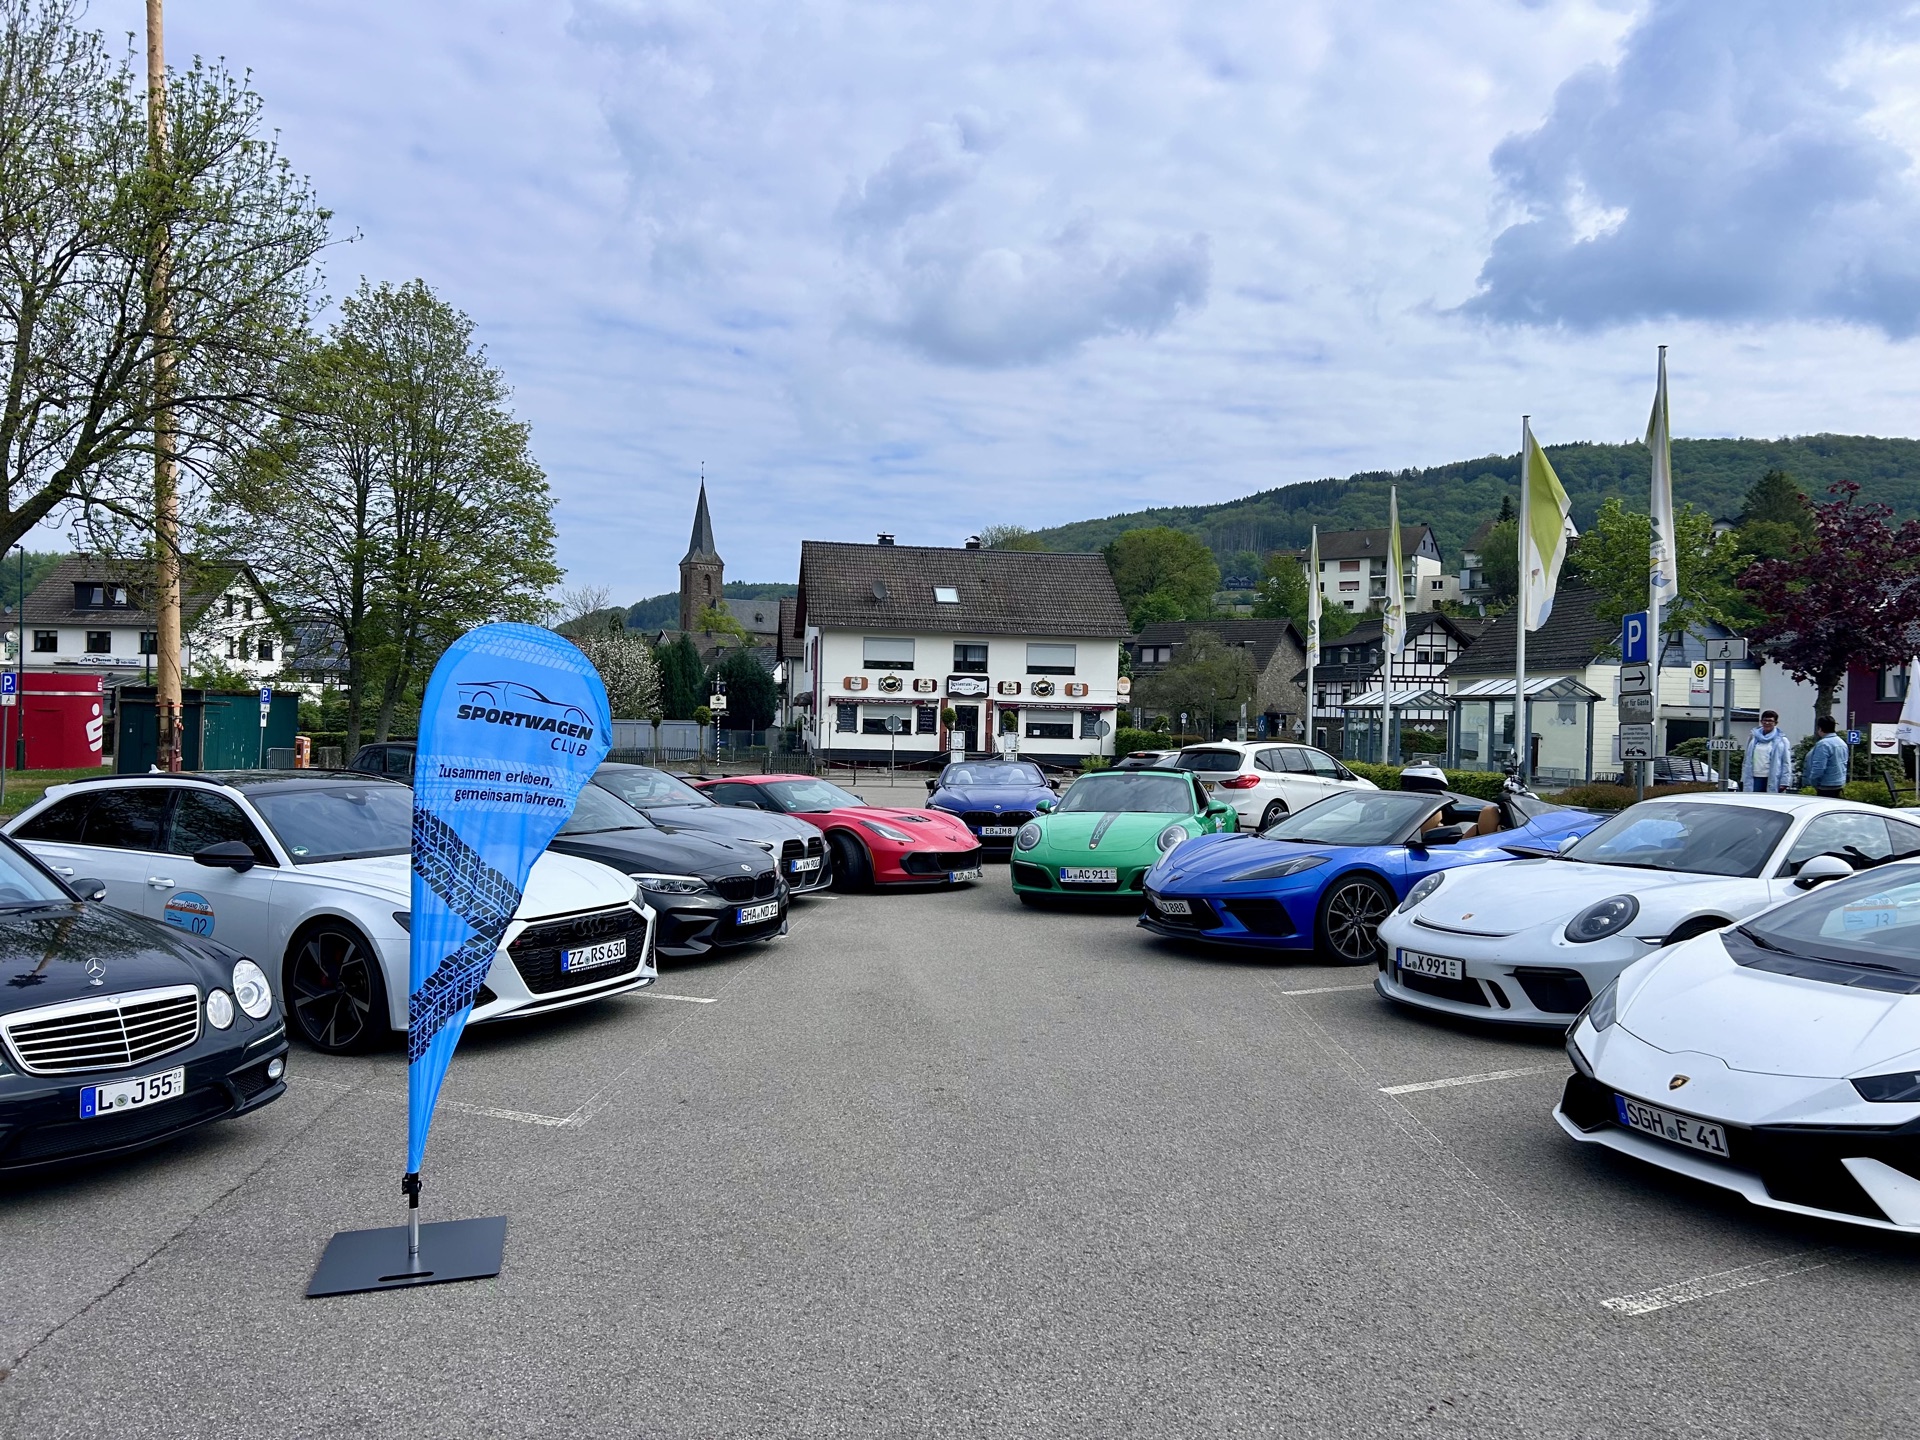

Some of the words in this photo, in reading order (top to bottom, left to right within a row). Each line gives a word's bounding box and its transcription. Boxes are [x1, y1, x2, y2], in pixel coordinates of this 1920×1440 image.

[1628, 620, 1641, 657] P
[1697, 667, 1704, 675] H
[4, 675, 12, 691] P
[262, 690, 269, 701] P
[1637, 698, 1649, 706] Gäste
[457, 704, 594, 741] SPORTWAGEN
[1711, 741, 1735, 749] KIOSK
[1850, 732, 1858, 742] P
[551, 737, 588, 757] CLUB
[439, 764, 501, 782] Zusammen
[506, 771, 553, 789] erleben,
[455, 788, 523, 803] gemeinsam
[985, 827, 995, 835] EB
[1066, 870, 1073, 879] L
[1078, 870, 1090, 879] AC
[1092, 870, 1110, 879] 911
[741, 908, 757, 922] GHA
[760, 905, 770, 917] ND
[770, 904, 778, 915] 21
[1169, 902, 1186, 912] 888
[192, 917, 207, 934] 02
[569, 950, 584, 967] ZZ
[591, 946, 605, 963] RS
[606, 941, 625, 959] 630
[1404, 953, 1411, 968] L
[1417, 955, 1424, 971] X
[1426, 957, 1448, 975] 991
[98, 1089, 114, 1111] L
[131, 1081, 145, 1104] J
[150, 1073, 173, 1099] 55
[1626, 1102, 1666, 1135] SGH
[1675, 1118, 1693, 1144] E
[1696, 1125, 1725, 1152] 41
